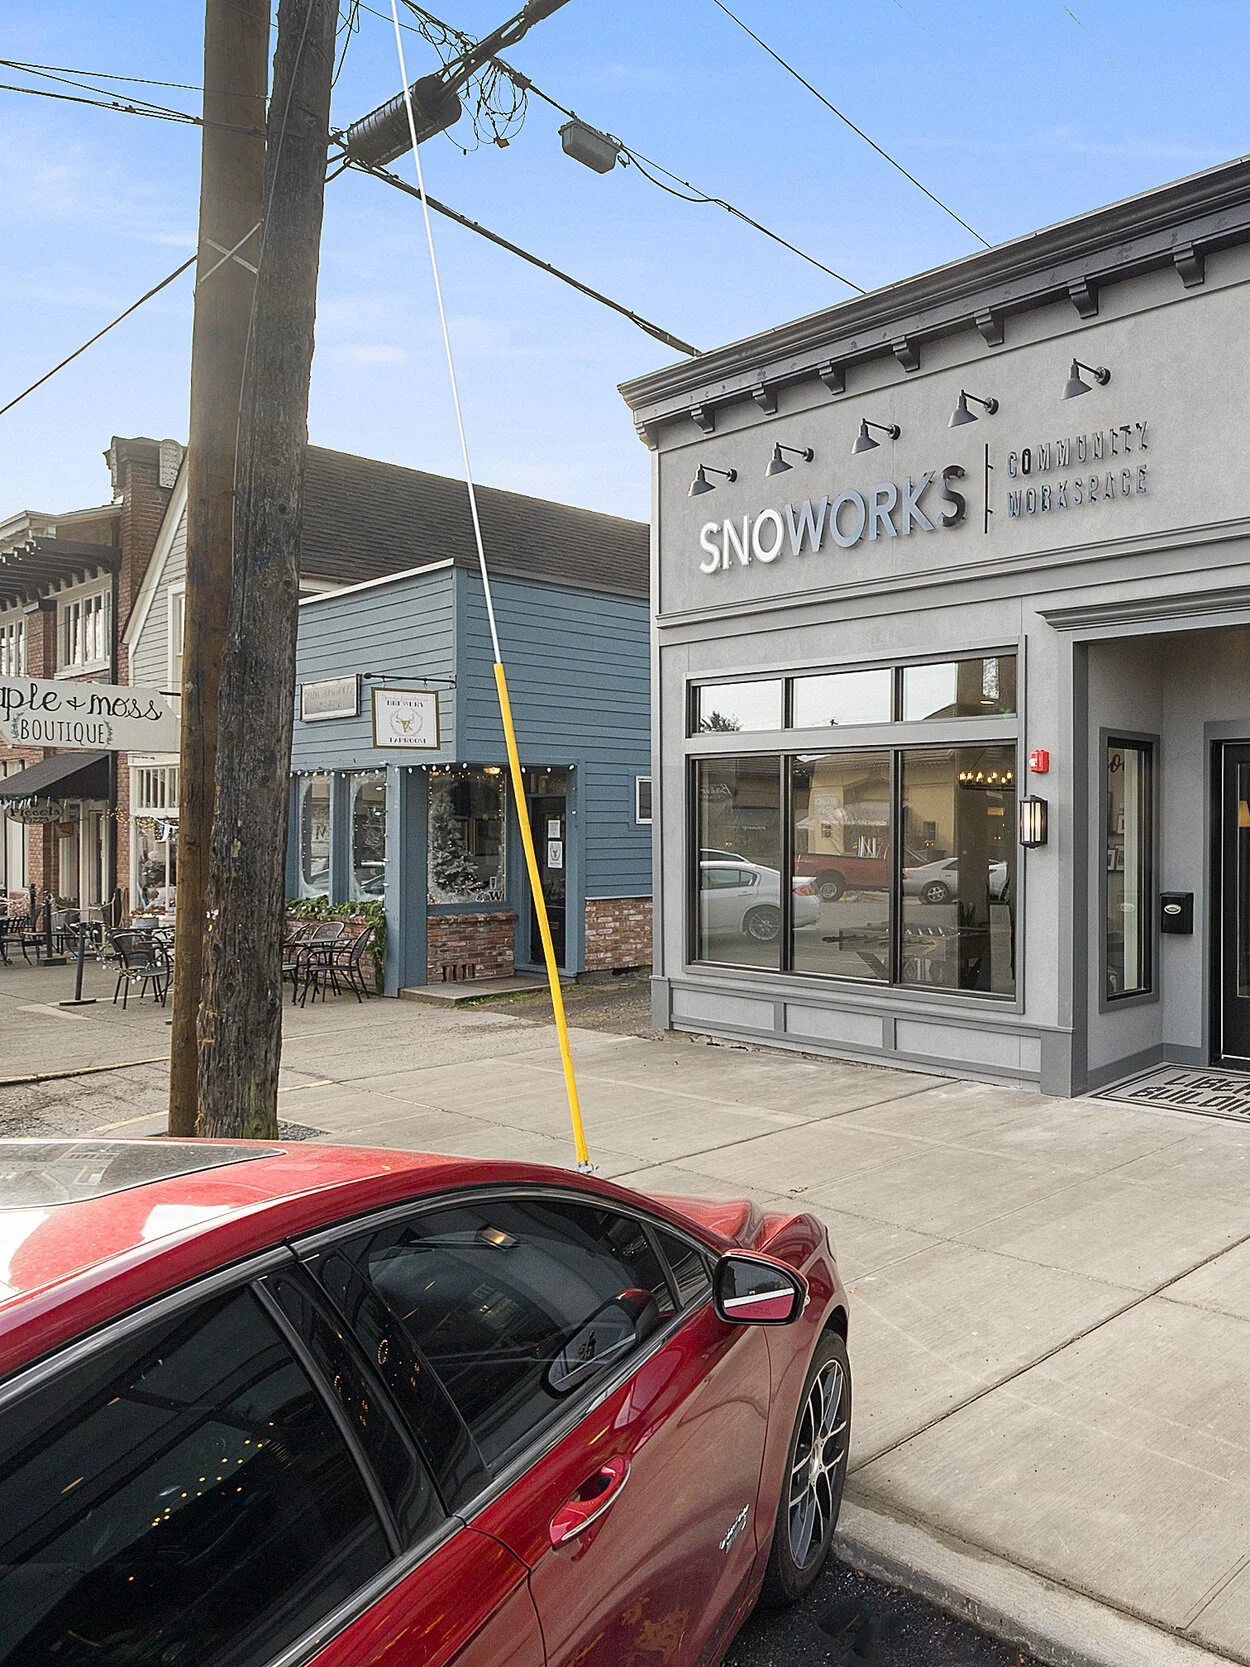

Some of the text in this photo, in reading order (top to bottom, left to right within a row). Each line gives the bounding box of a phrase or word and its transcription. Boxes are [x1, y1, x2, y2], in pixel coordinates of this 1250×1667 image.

[1007, 421, 1148, 479] COMMUNITY
[1007, 464, 1147, 518] WORKSPACE
[699, 464, 967, 575] SNOWORKS
[21, 719, 105, 746] BOUTIQUE
[87, 694, 163, 721] moss
